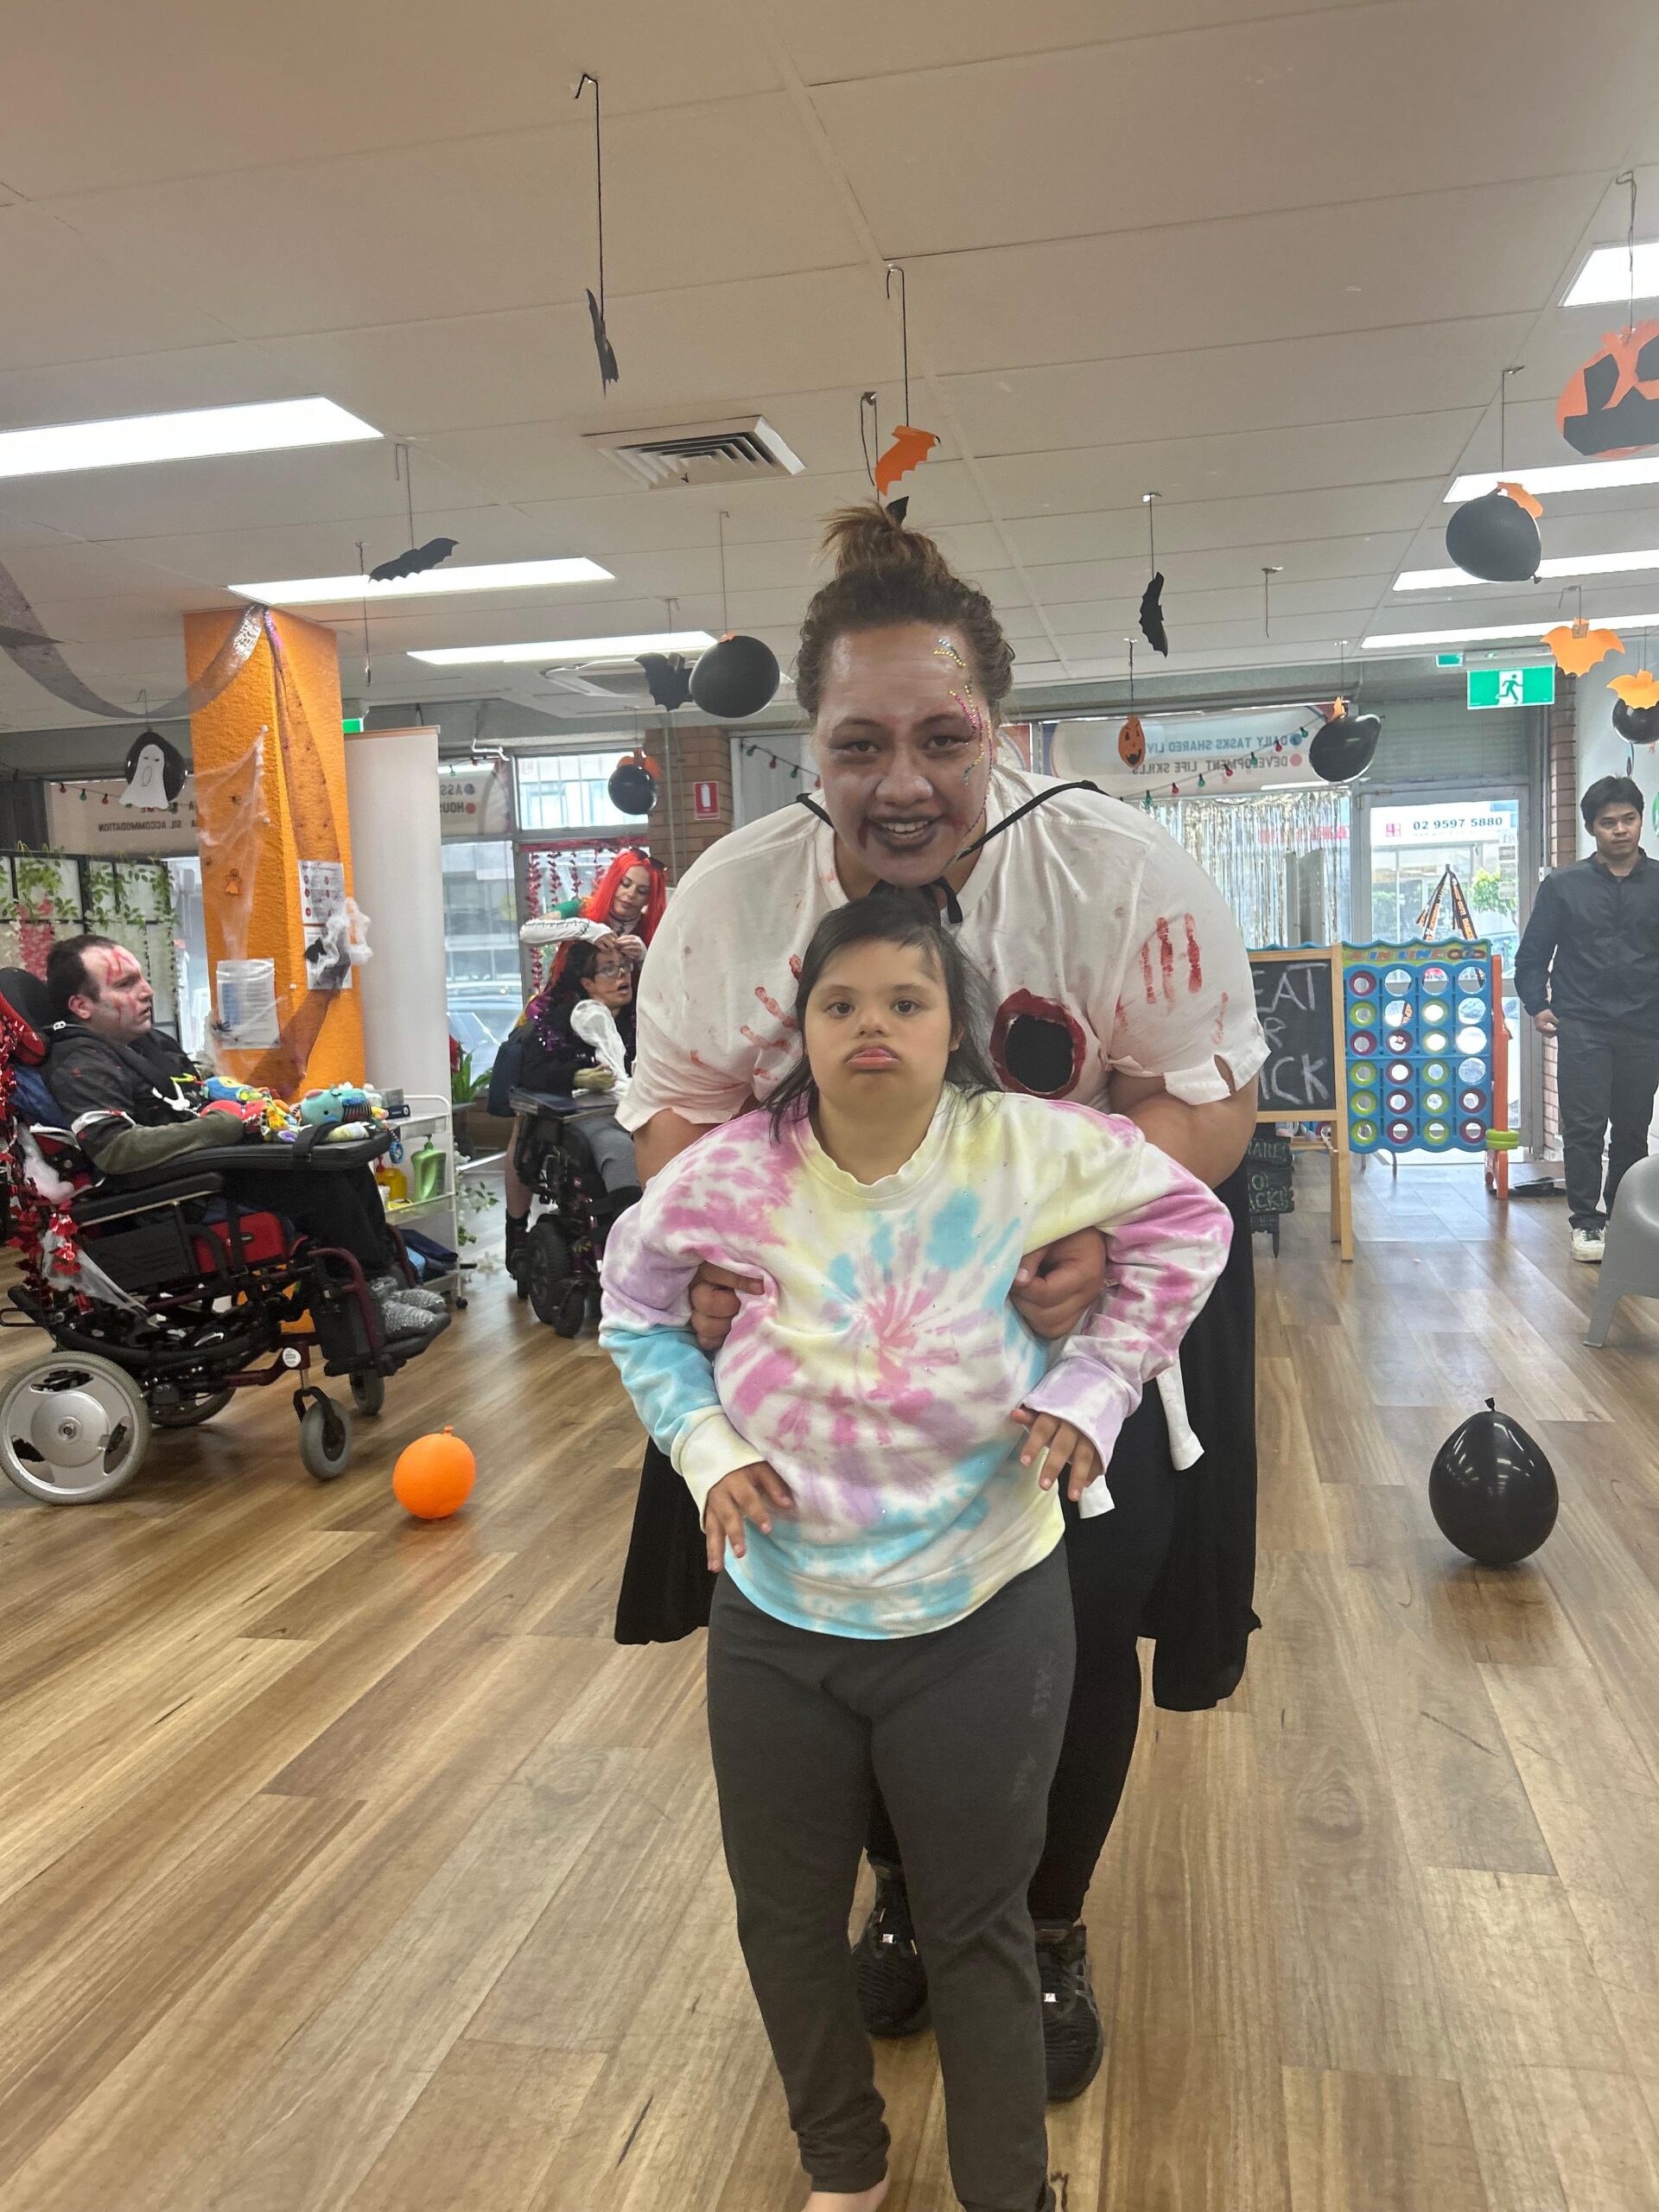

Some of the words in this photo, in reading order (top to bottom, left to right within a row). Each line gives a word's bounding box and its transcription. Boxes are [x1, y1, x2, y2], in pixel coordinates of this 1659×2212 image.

[1413, 821, 1428, 830] 02
[1433, 818, 1465, 830] 9597
[1471, 817, 1503, 828] 5880
[1367, 950, 1394, 962] IN
[1396, 949, 1446, 962] LINE
[1252, 962, 1328, 1014] EAT
[1264, 1016, 1287, 1049] R
